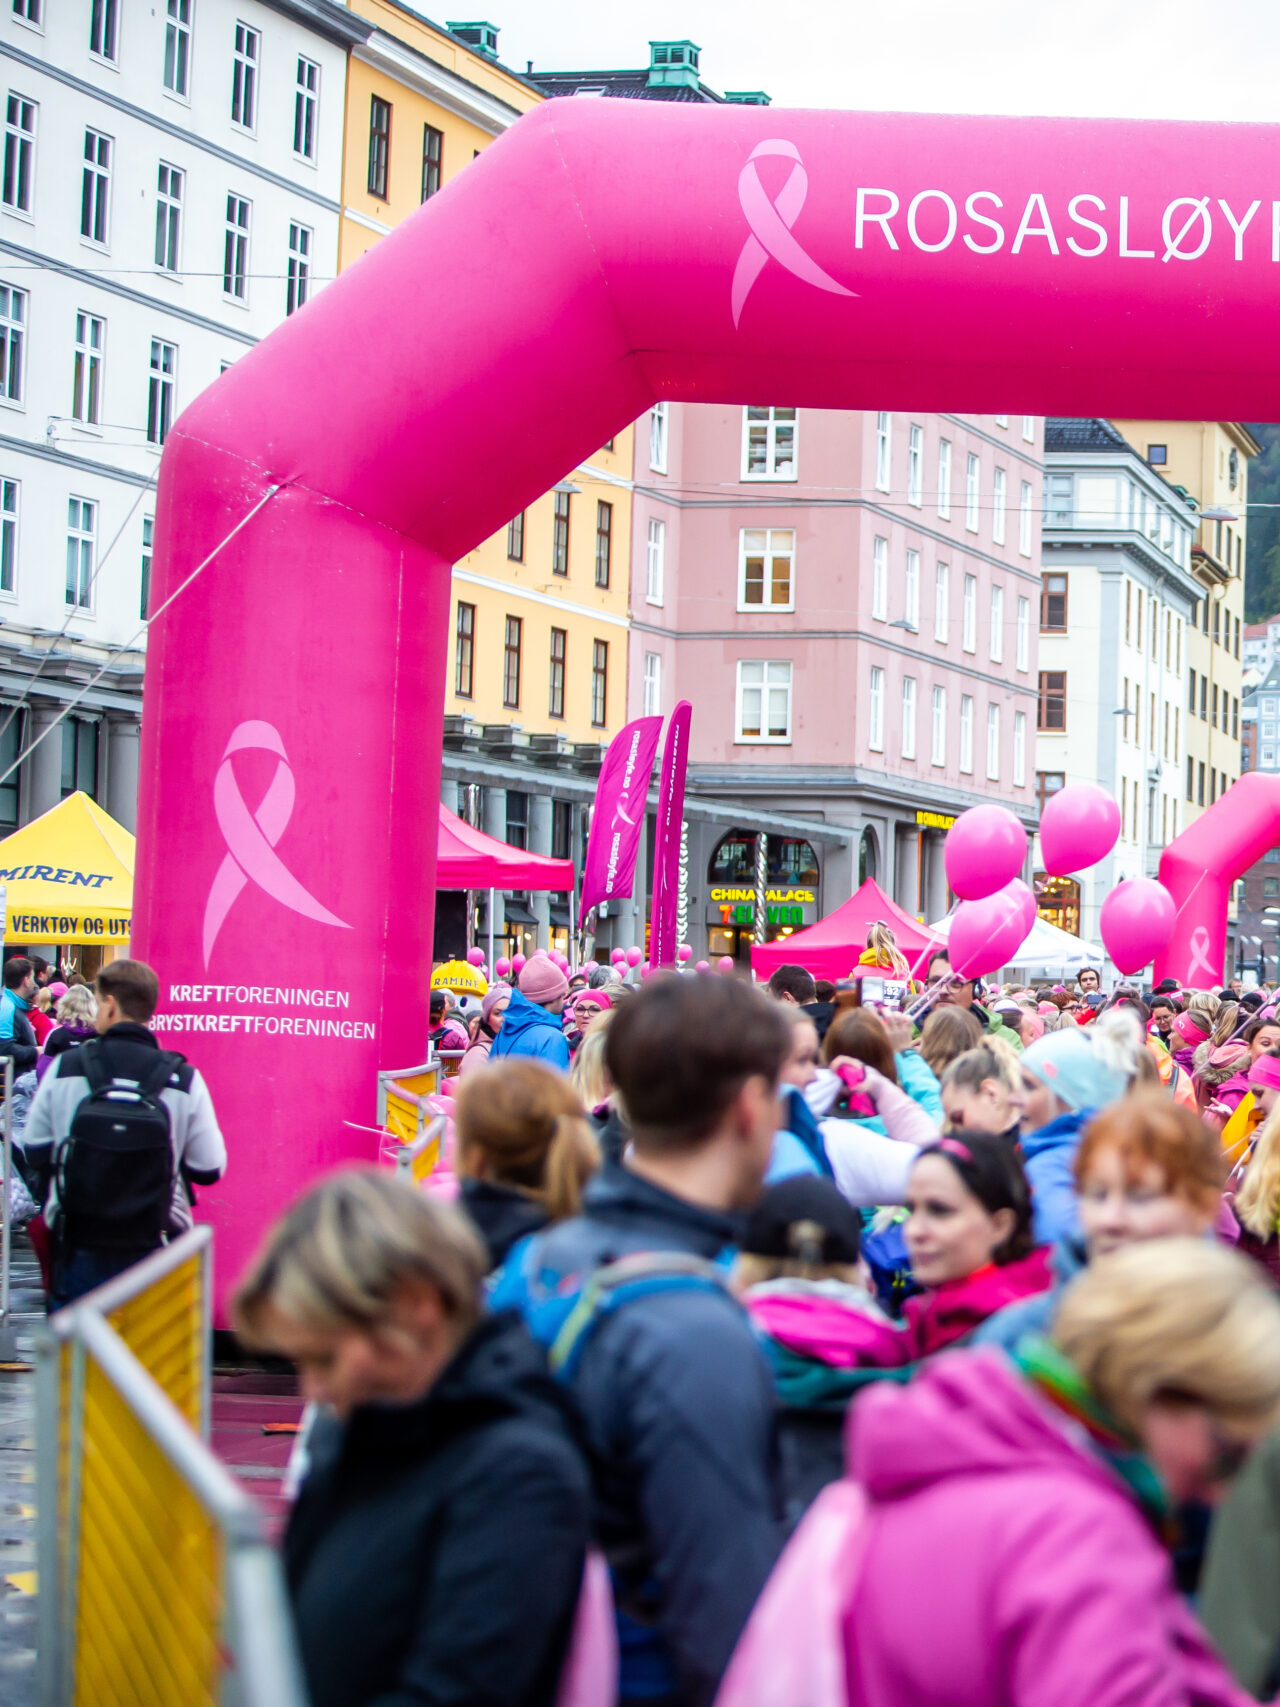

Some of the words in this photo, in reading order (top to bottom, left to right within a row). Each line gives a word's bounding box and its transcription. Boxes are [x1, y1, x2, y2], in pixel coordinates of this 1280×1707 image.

[711, 888, 756, 901] CHINA
[765, 889, 815, 902] ALACE
[12, 915, 78, 934] VERKTØY
[83, 917, 104, 935] OG
[170, 985, 350, 1008] KREFTFORENINGEN
